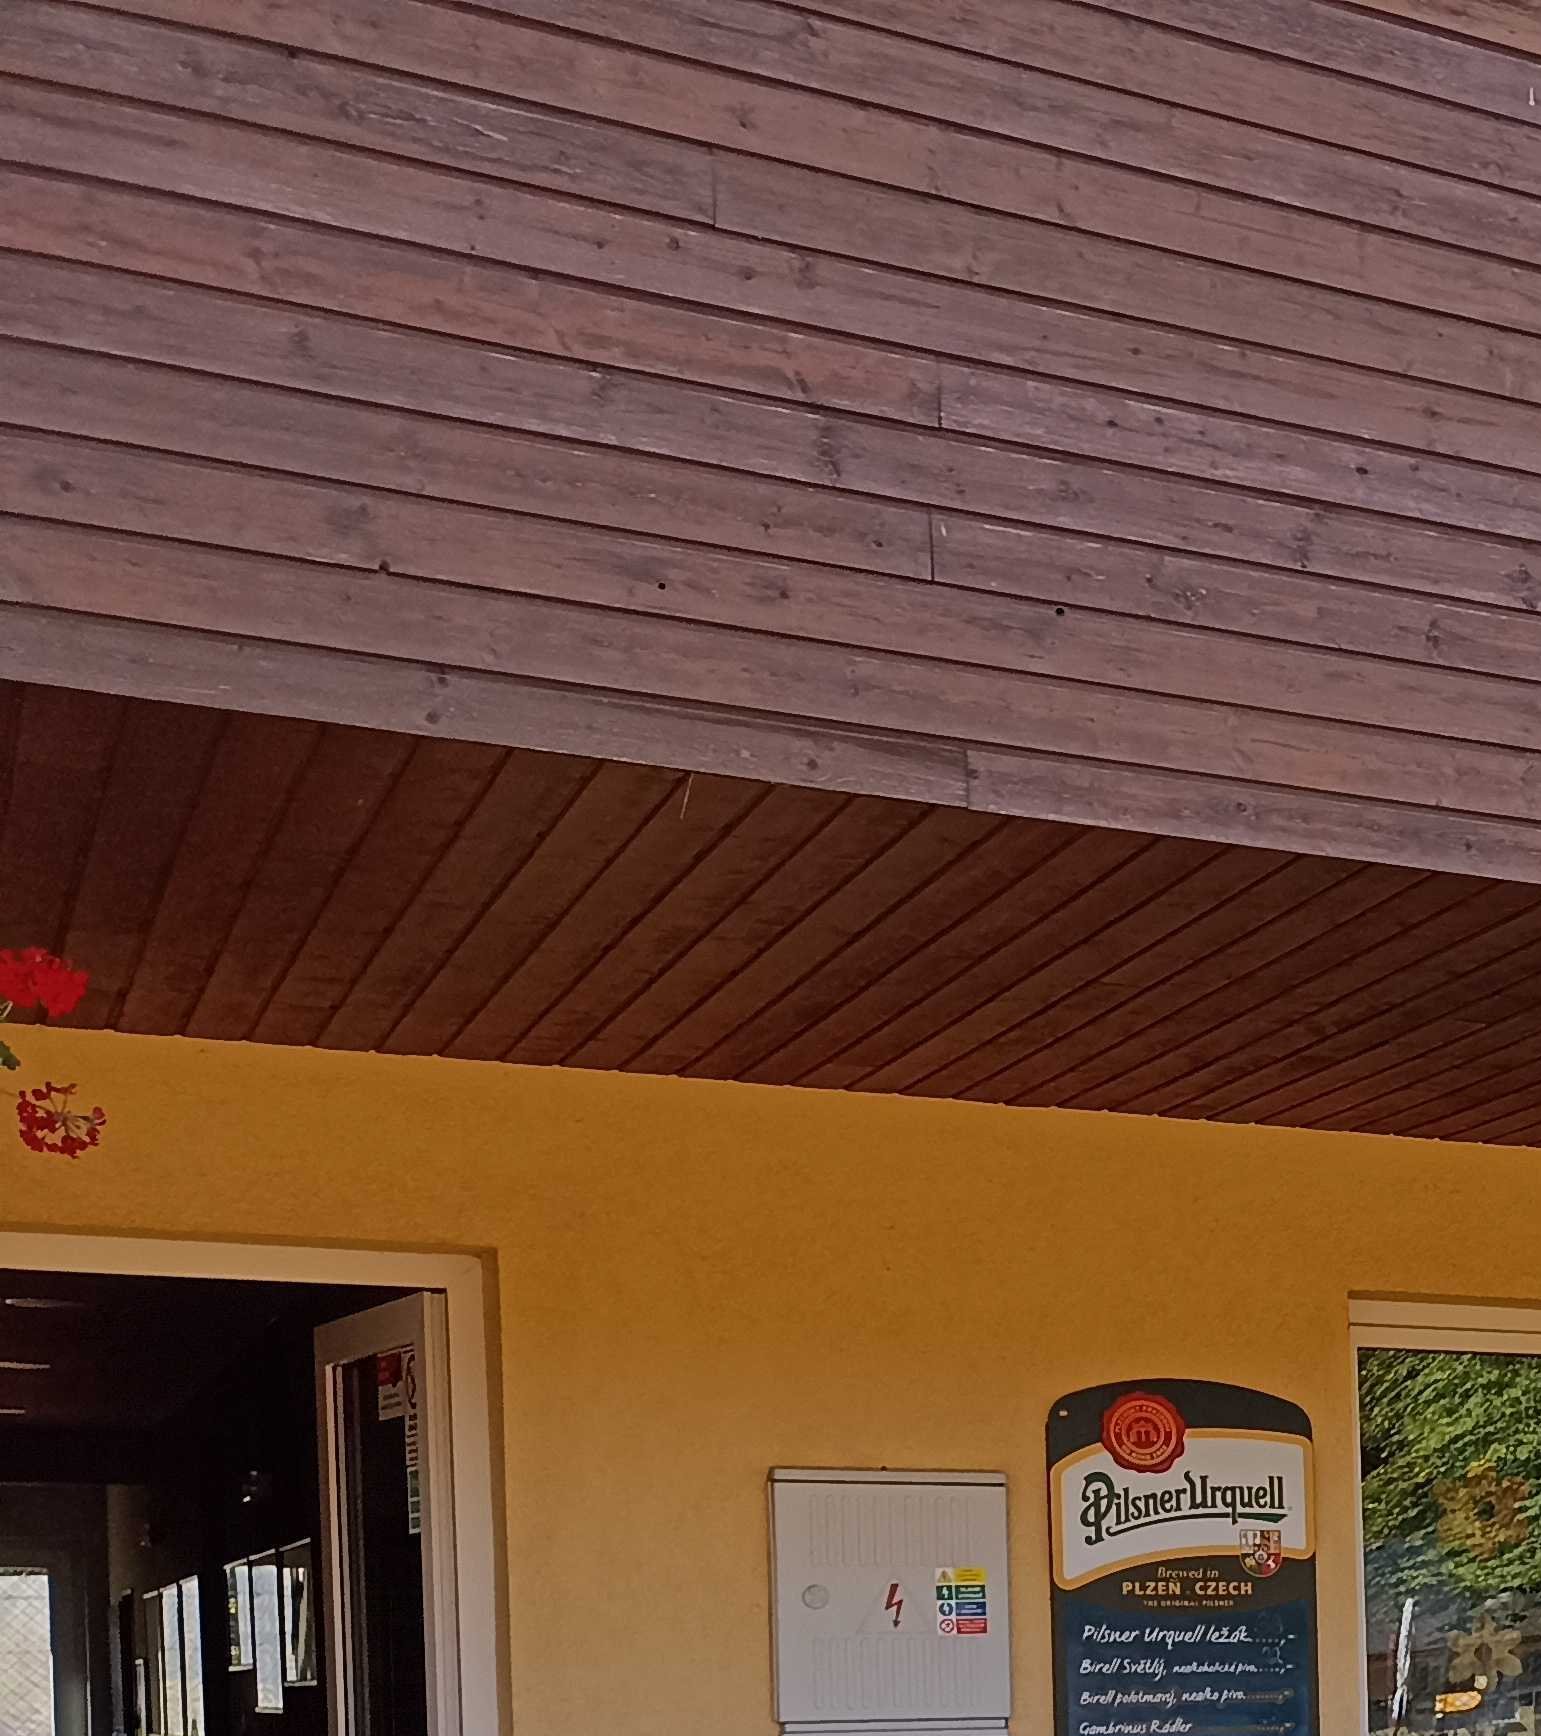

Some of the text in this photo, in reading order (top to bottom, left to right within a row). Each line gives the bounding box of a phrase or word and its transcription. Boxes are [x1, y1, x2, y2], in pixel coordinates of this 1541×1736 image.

[1080, 1470, 1285, 1546] Pilsner Urquell
[1157, 1567, 1219, 1579] Brewed in
[1122, 1578, 1253, 1595] PLZEŇ CZECH
[1082, 1624, 1140, 1643] Pilsner
[1144, 1624, 1206, 1650] Urquell
[1080, 1657, 1121, 1673] Birell
[1080, 1689, 1116, 1704] Birell
[1079, 1721, 1147, 1735] Gambrinus
